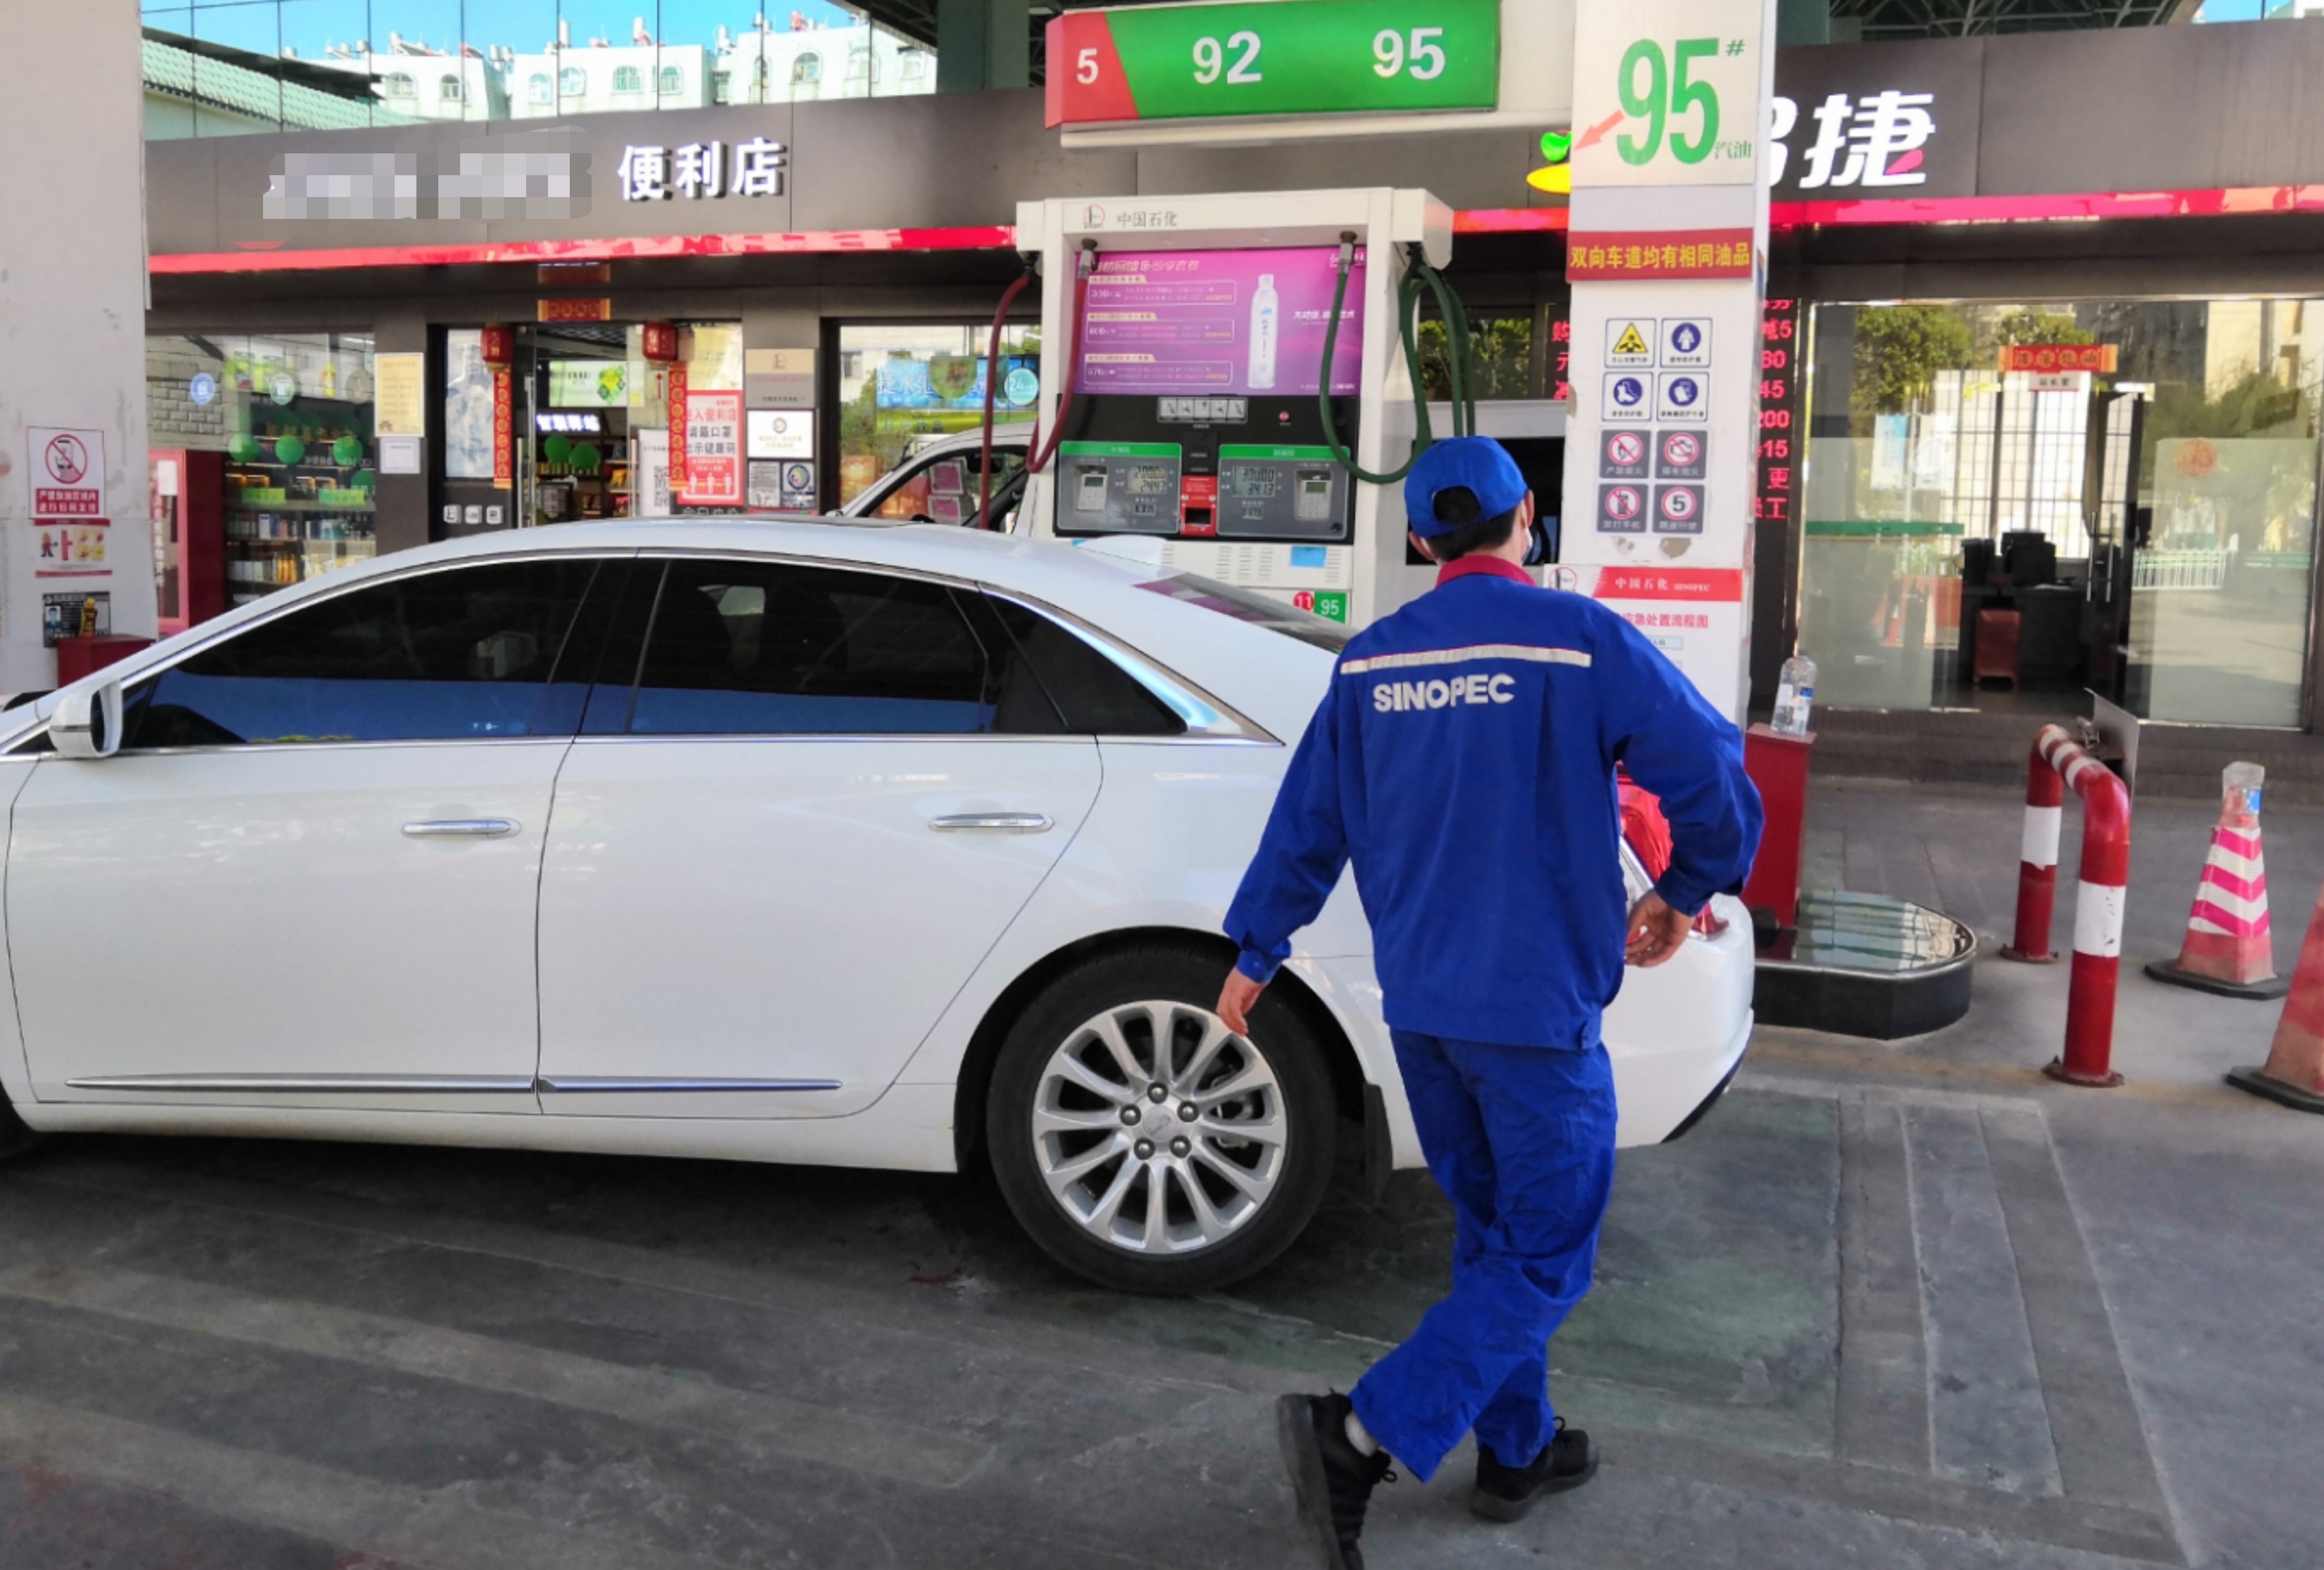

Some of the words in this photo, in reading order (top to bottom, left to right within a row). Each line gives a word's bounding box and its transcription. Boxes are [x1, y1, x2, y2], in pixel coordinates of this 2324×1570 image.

[1076, 48, 1099, 84] 5
[1193, 30, 1262, 84] 92
[1373, 27, 1446, 80] 95
[1714, 140, 1752, 160] 汽油
[618, 136, 783, 201] 便利店
[1117, 211, 1178, 228] 中国石化
[1570, 242, 1750, 269] 双向车道均有相同油品
[1673, 494, 1686, 512] 5
[1615, 576, 1668, 589] 中国石化
[1321, 599, 1339, 615] 95
[1373, 673, 1515, 713] SINOPEC
